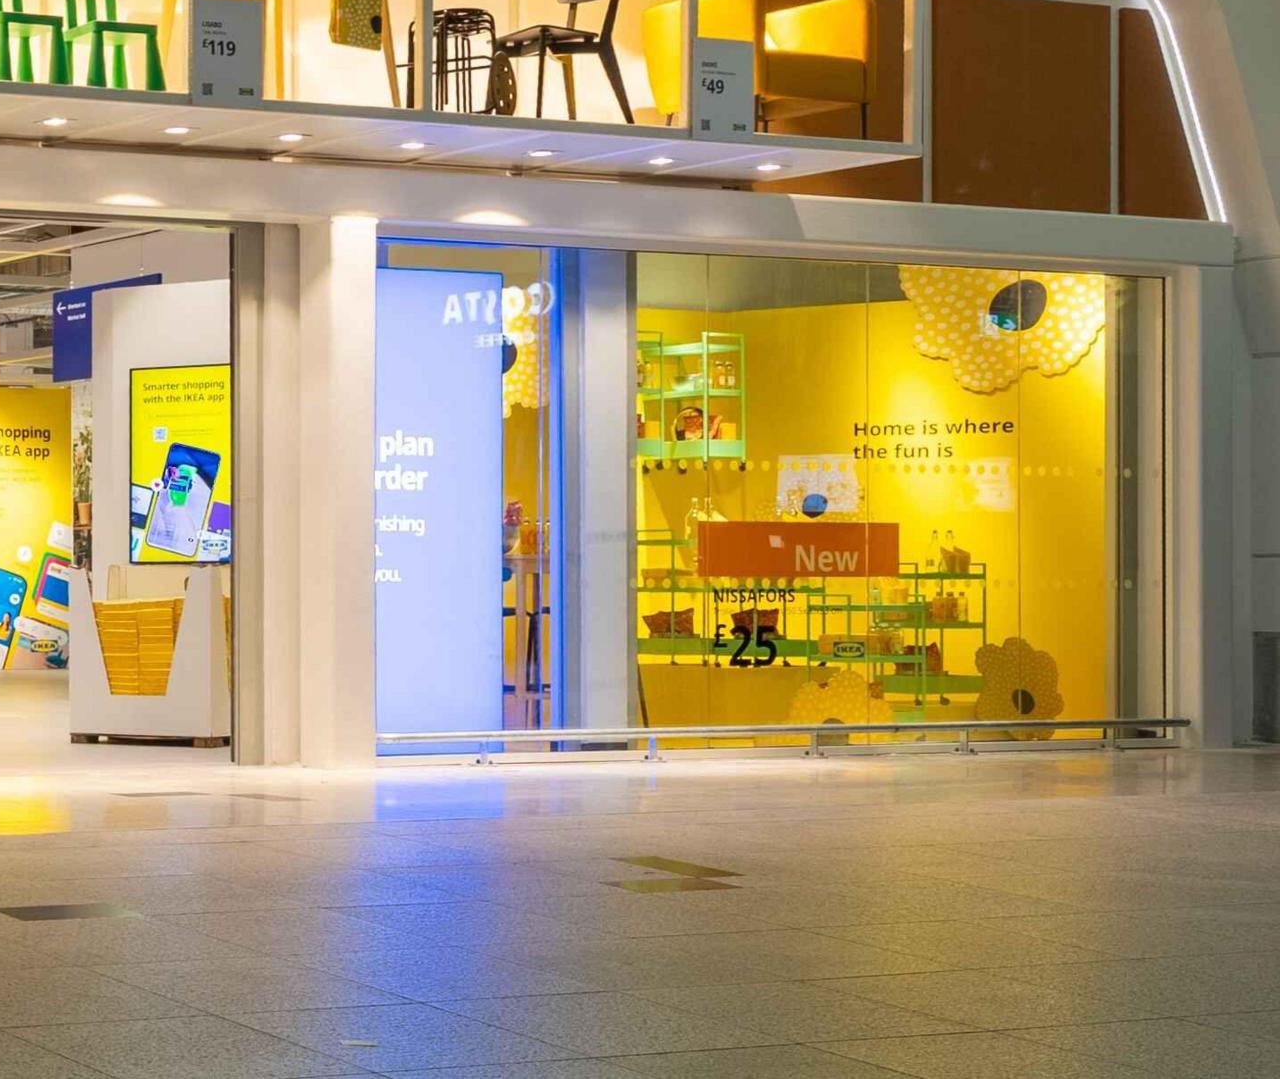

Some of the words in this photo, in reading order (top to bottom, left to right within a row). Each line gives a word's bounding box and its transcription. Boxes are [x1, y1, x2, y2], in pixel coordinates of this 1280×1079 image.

[201, 37, 237, 57] £119
[701, 77, 725, 95] £49
[143, 382, 180, 392] Smarter
[182, 380, 225, 391] shopping
[143, 395, 164, 404] with
[165, 394, 182, 403] the
[184, 393, 205, 402] IKEA
[207, 394, 225, 403] app
[853, 422, 915, 437] Home
[922, 420, 939, 435] is
[945, 418, 1015, 434] where
[25, 447, 50, 461] app
[379, 429, 434, 463] plan
[853, 444, 888, 459] the
[895, 443, 930, 459] fun
[937, 442, 954, 458] is
[374, 463, 429, 491] rder
[794, 544, 860, 573] New
[713, 588, 796, 604] NISSAFORS
[713, 623, 778, 668] £25
